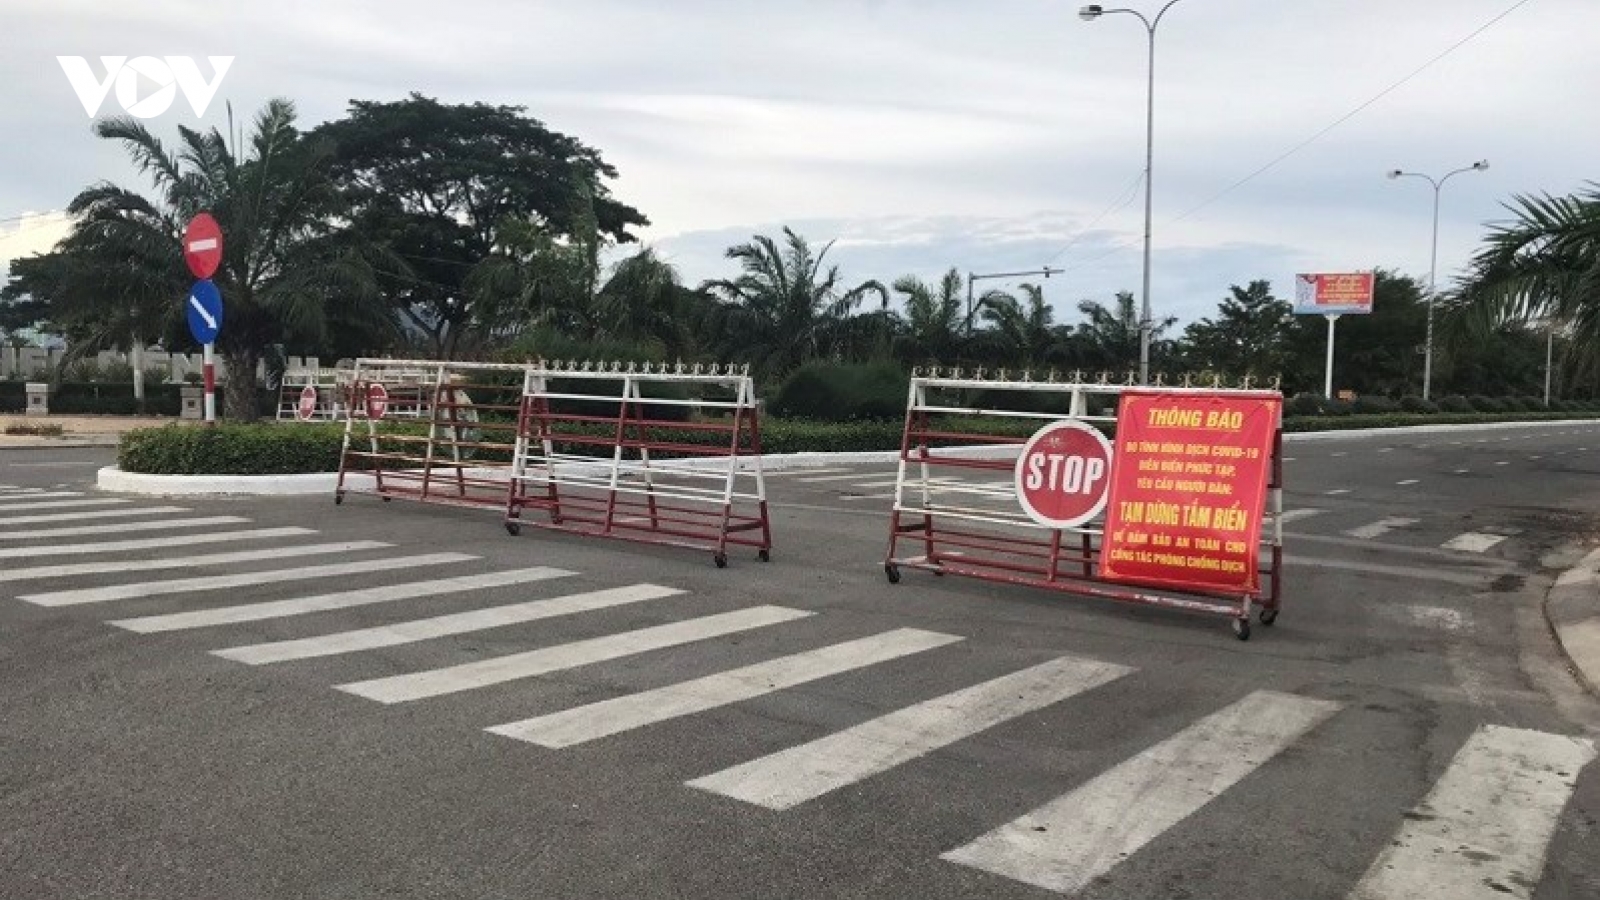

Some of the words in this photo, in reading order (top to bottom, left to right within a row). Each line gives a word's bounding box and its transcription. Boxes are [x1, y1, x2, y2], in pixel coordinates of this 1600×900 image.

[1149, 406, 1203, 427] THÔNG
[1206, 408, 1243, 429] BÁO
[1211, 445, 1259, 458] COVID-19
[1026, 451, 1104, 495] STOP
[1120, 501, 1144, 526] TẠM
[1145, 499, 1180, 525] DỪNG
[1213, 500, 1248, 531] BIỂN
[1175, 537, 1190, 547] AN
[1195, 537, 1220, 550] TOÀN
[1225, 540, 1246, 552] CHO
[1110, 548, 1134, 561] CÔNG
[1135, 551, 1152, 562] TÁC
[1153, 553, 1186, 567] PHÒNG
[1187, 555, 1220, 569] CHỐNG
[1221, 560, 1246, 573] DỊCH
